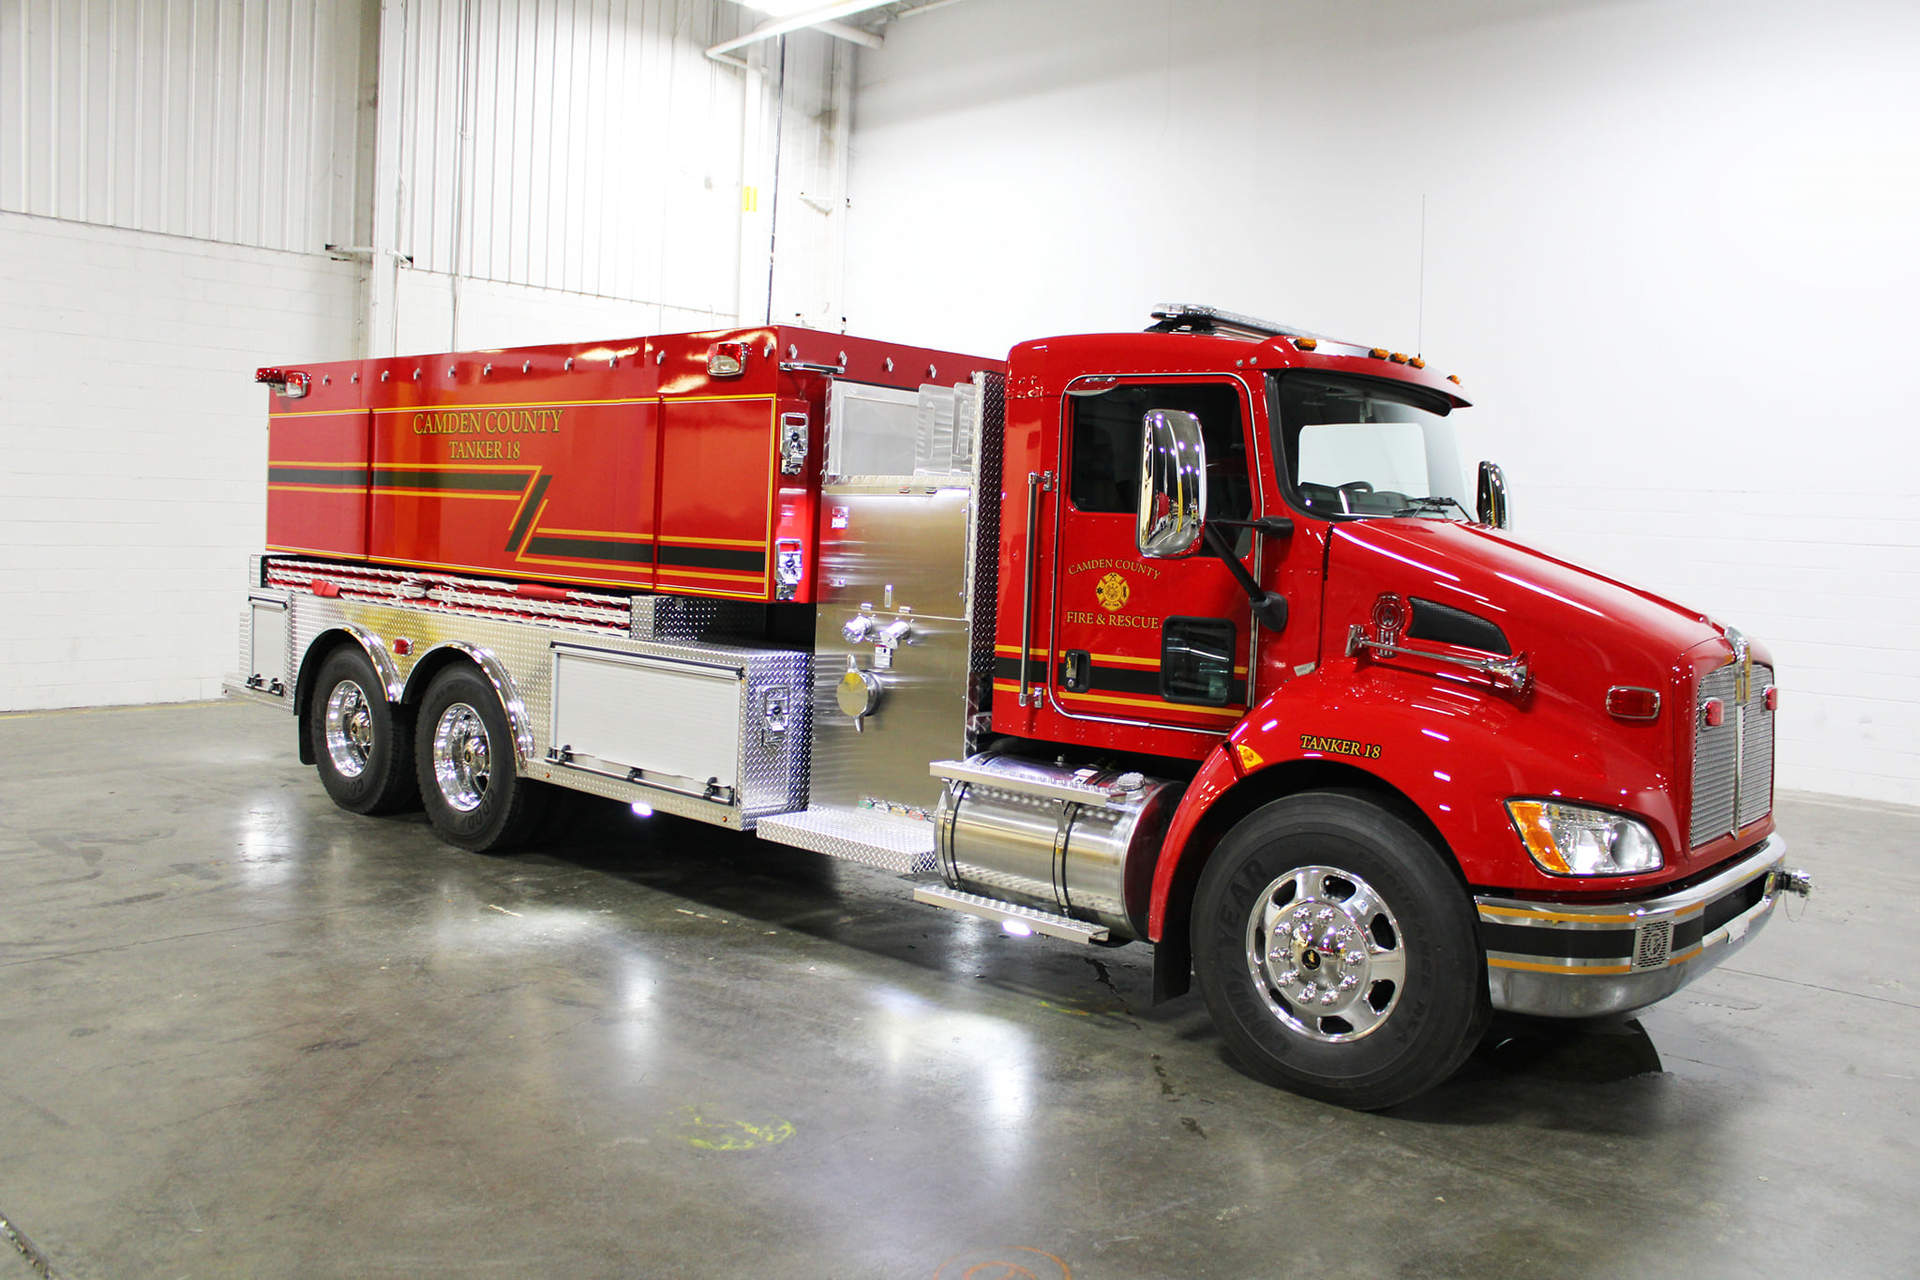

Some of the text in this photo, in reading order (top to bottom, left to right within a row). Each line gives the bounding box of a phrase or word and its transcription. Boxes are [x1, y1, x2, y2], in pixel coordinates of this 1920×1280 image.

[413, 409, 563, 434] CAMDEN COUNTY
[449, 441, 521, 459] TANKER 18
[1068, 559, 1161, 580] CAMDEN COUNTY
[1066, 611, 1159, 629] FIRE & RESCUE
[1300, 734, 1382, 759] TANKER 18
